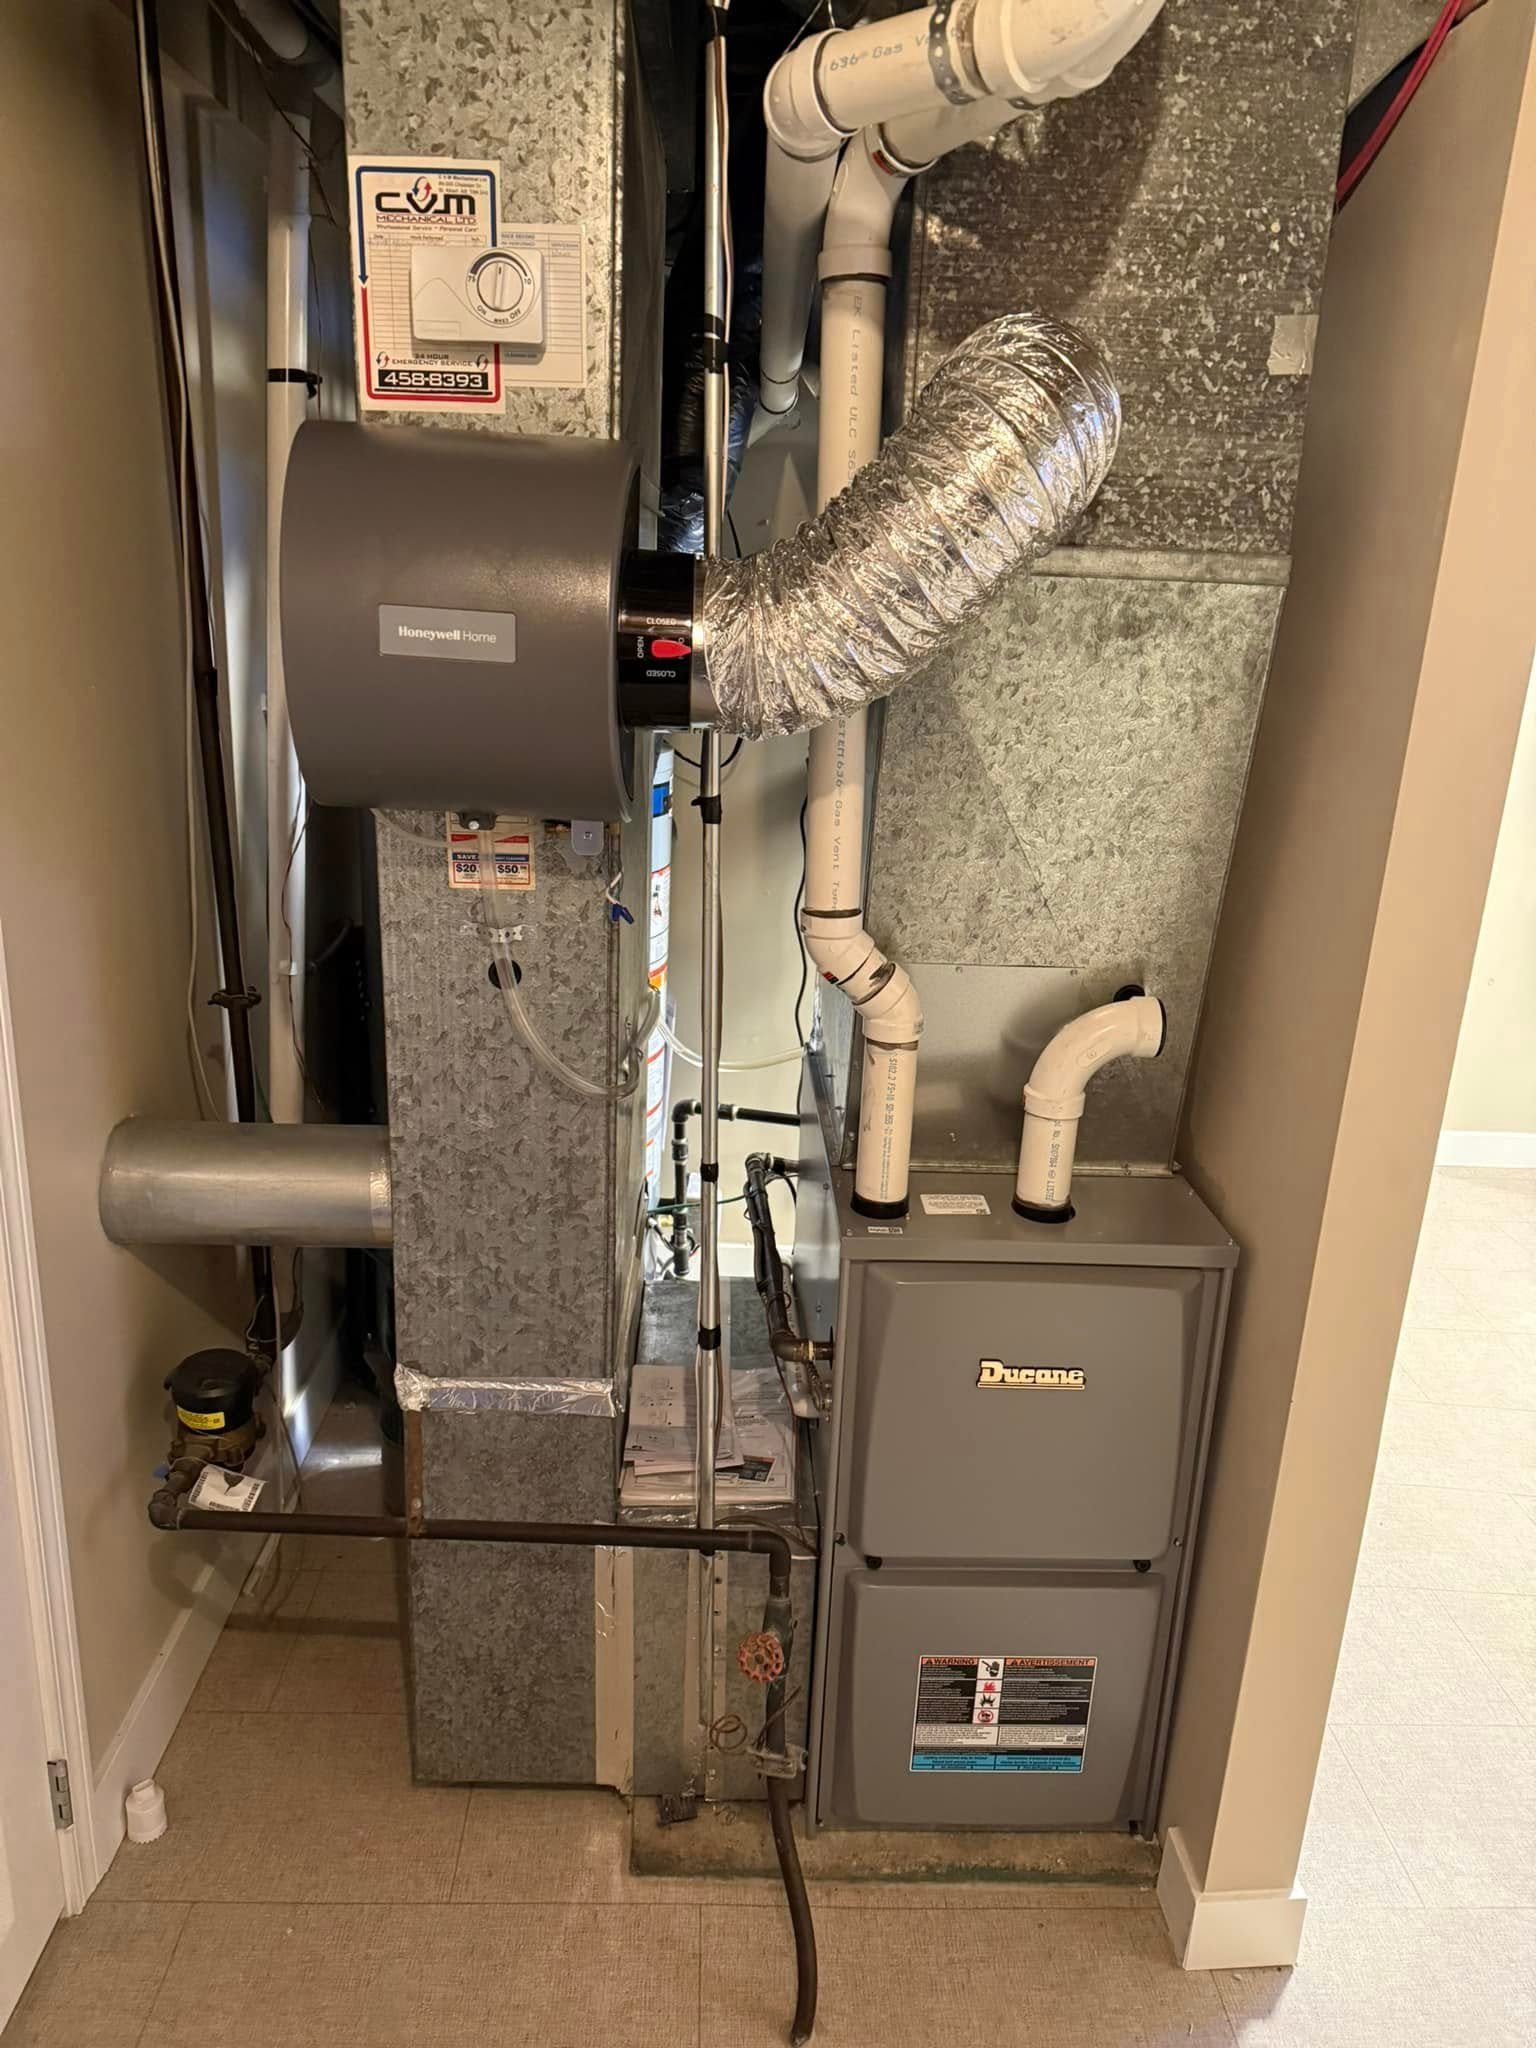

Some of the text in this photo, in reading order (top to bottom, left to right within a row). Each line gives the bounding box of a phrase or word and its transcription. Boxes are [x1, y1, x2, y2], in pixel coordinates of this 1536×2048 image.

[872, 43, 903, 59] Gas
[376, 214, 453, 225] MECHANICAL
[477, 305, 487, 315] ON
[509, 308, 521, 319] OFF
[850, 329, 861, 396] Listed
[384, 372, 482, 388] 458-8393
[849, 407, 858, 438] ULC
[646, 617, 677, 625] CLOSED
[398, 625, 497, 643] Honeywell Home
[637, 636, 645, 659] OPEN
[646, 669, 676, 678] CLOSED
[833, 799, 842, 827] Gas
[832, 836, 842, 870] Vent
[980, 1360, 1084, 1384] Ducane
[934, 1657, 975, 1665] WARNING
[1020, 1658, 1089, 1666] AVERTISSEMENT
